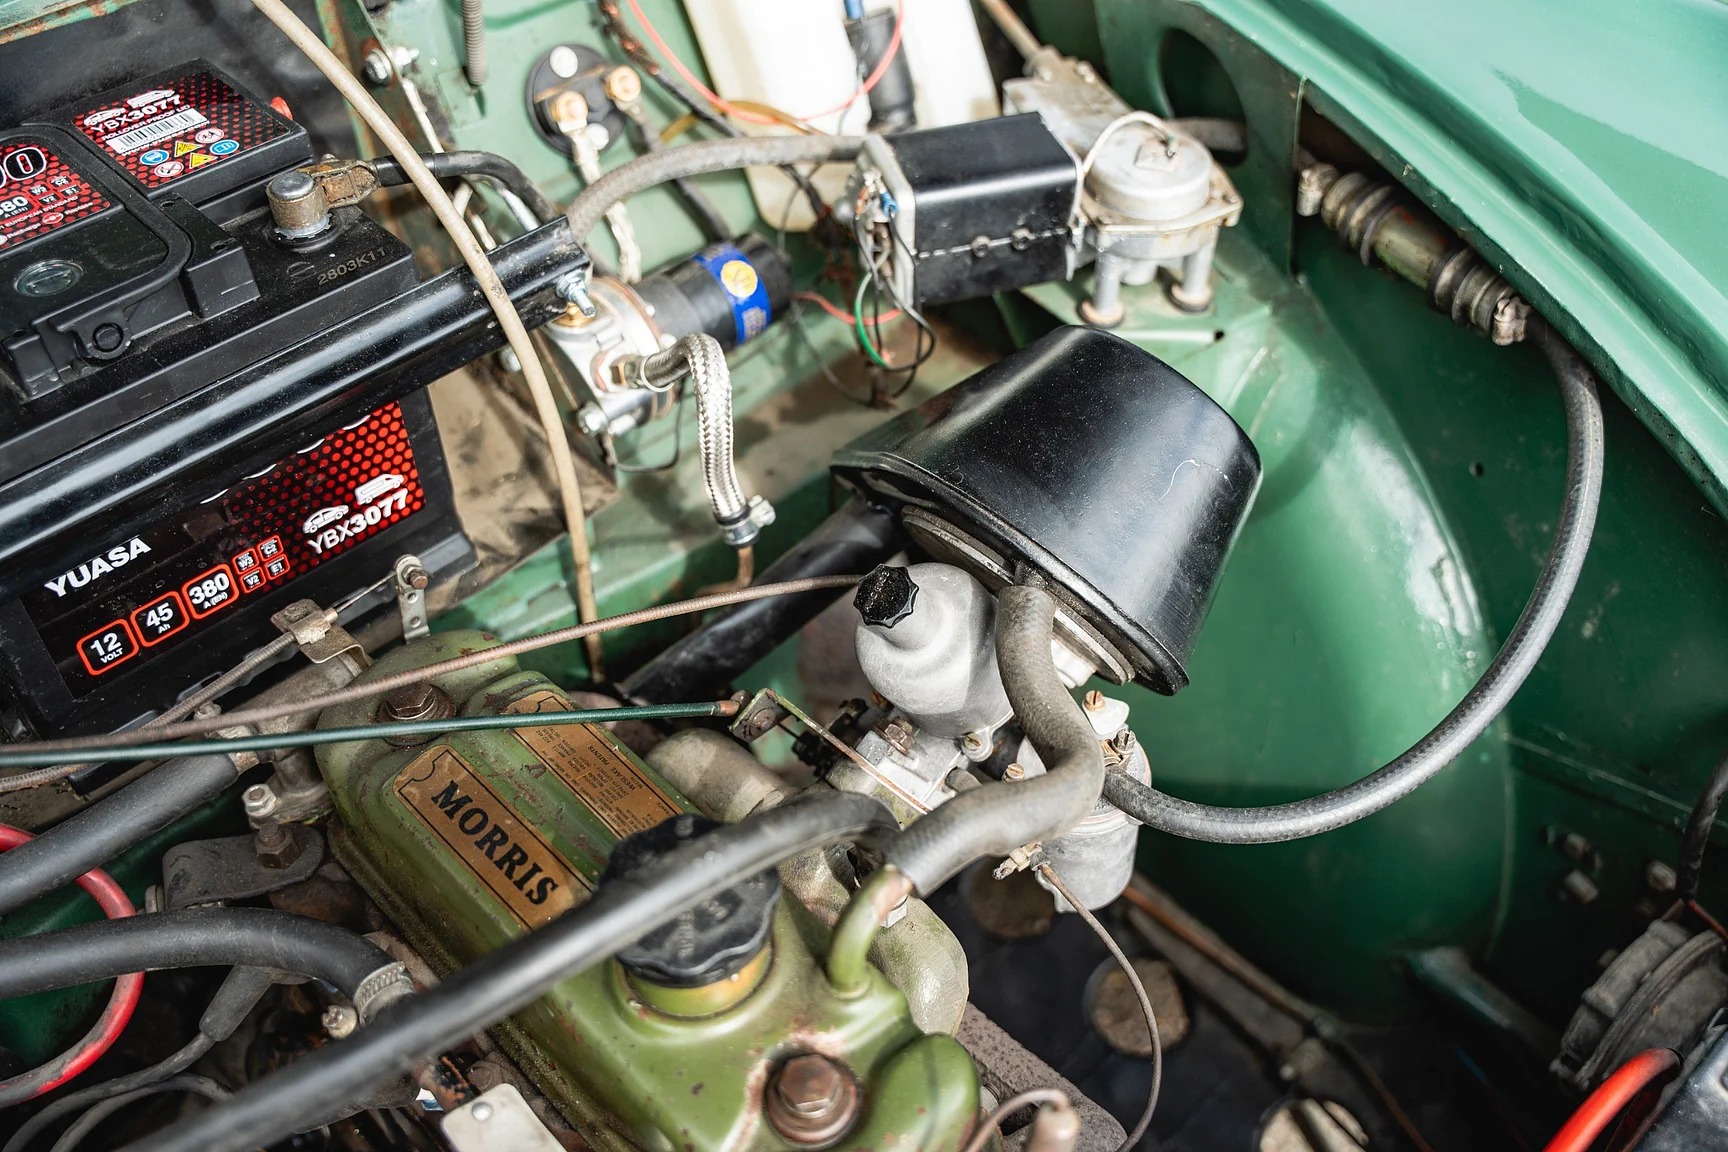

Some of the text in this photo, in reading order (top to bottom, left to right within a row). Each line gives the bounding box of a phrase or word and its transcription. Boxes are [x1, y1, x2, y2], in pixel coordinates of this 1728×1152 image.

[91, 95, 180, 133] YBX3077
[102, 120, 146, 141] ROLLOVER
[147, 111, 175, 124] PROOF
[0, 196, 28, 215] 80
[6, 196, 78, 227] EUROPEAN STANDARD
[65, 202, 94, 215] Replace
[7, 222, 41, 238] Recharge
[318, 248, 386, 285] 2803K11
[307, 488, 408, 554] YBX3077
[264, 544, 277, 555] C2
[44, 535, 152, 599] YUASA
[188, 573, 230, 605] 380
[246, 575, 259, 586] V2
[203, 592, 228, 609] A (EN)
[146, 602, 174, 627] 45
[158, 623, 171, 634] Ah
[91, 632, 122, 656] 12
[100, 647, 123, 664] VOLT
[586, 743, 610, 767] PATENTS
[609, 765, 636, 791] WESLAKE
[432, 780, 558, 906] MORRIS
